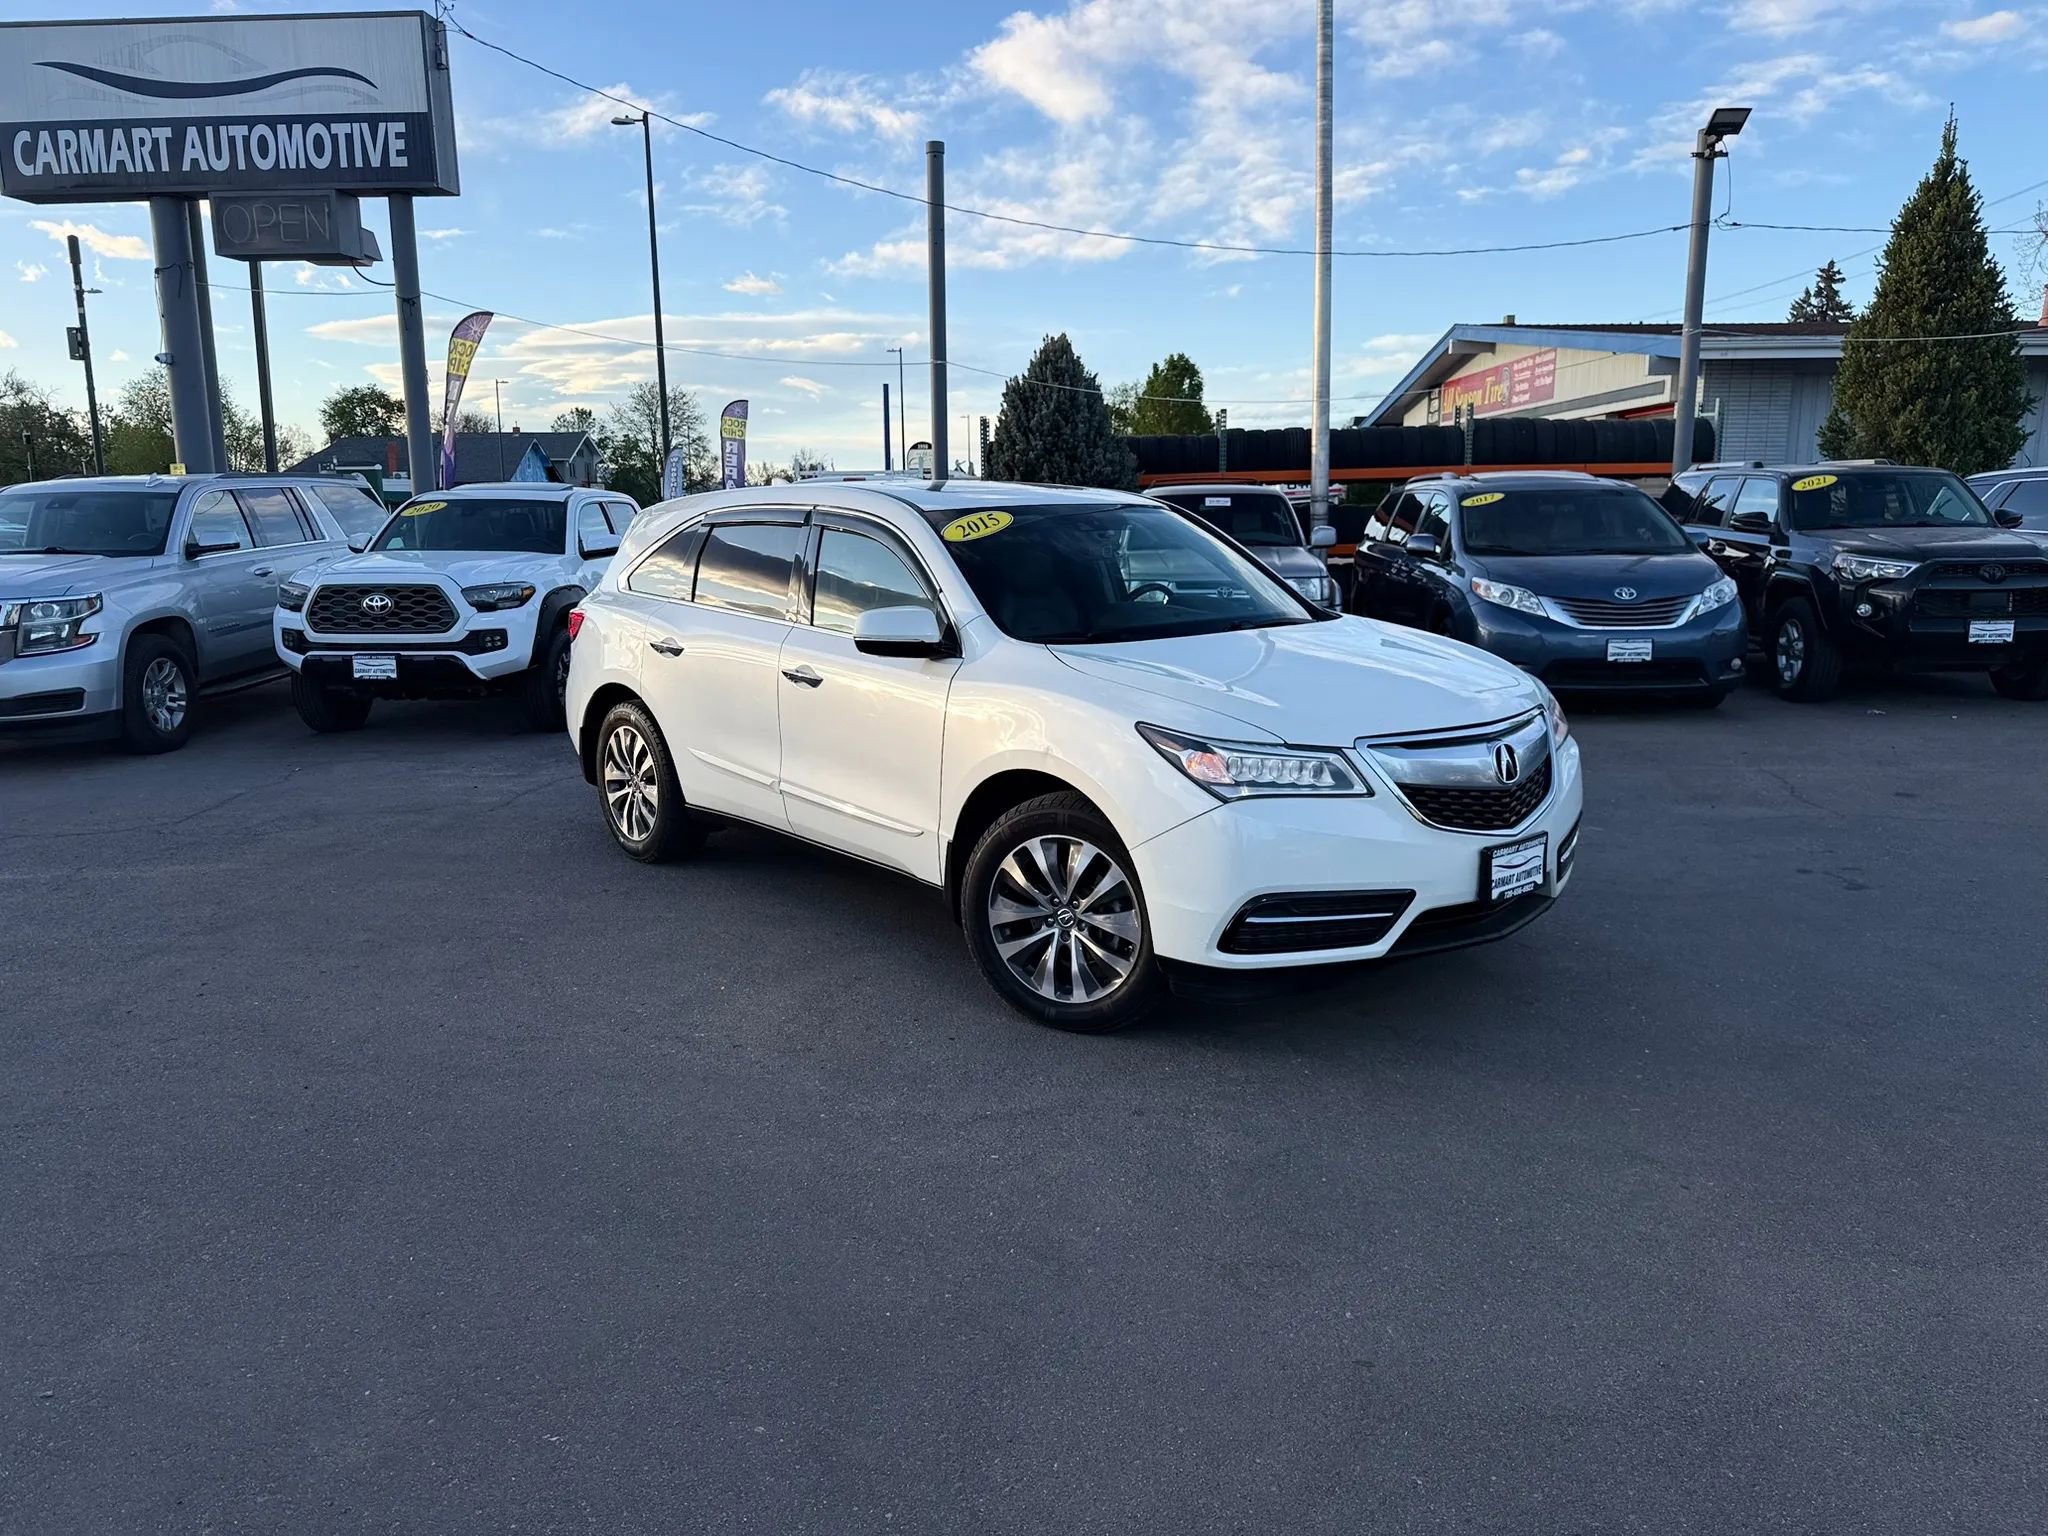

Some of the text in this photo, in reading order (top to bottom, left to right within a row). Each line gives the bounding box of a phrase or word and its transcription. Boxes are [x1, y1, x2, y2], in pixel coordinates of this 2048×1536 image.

[13, 121, 408, 177] CARMART AUTOMOTIVE
[222, 203, 330, 243] OPEN
[1801, 476, 1826, 490] 2021
[1471, 494, 1495, 506] 2017
[955, 513, 1000, 538] 2015
